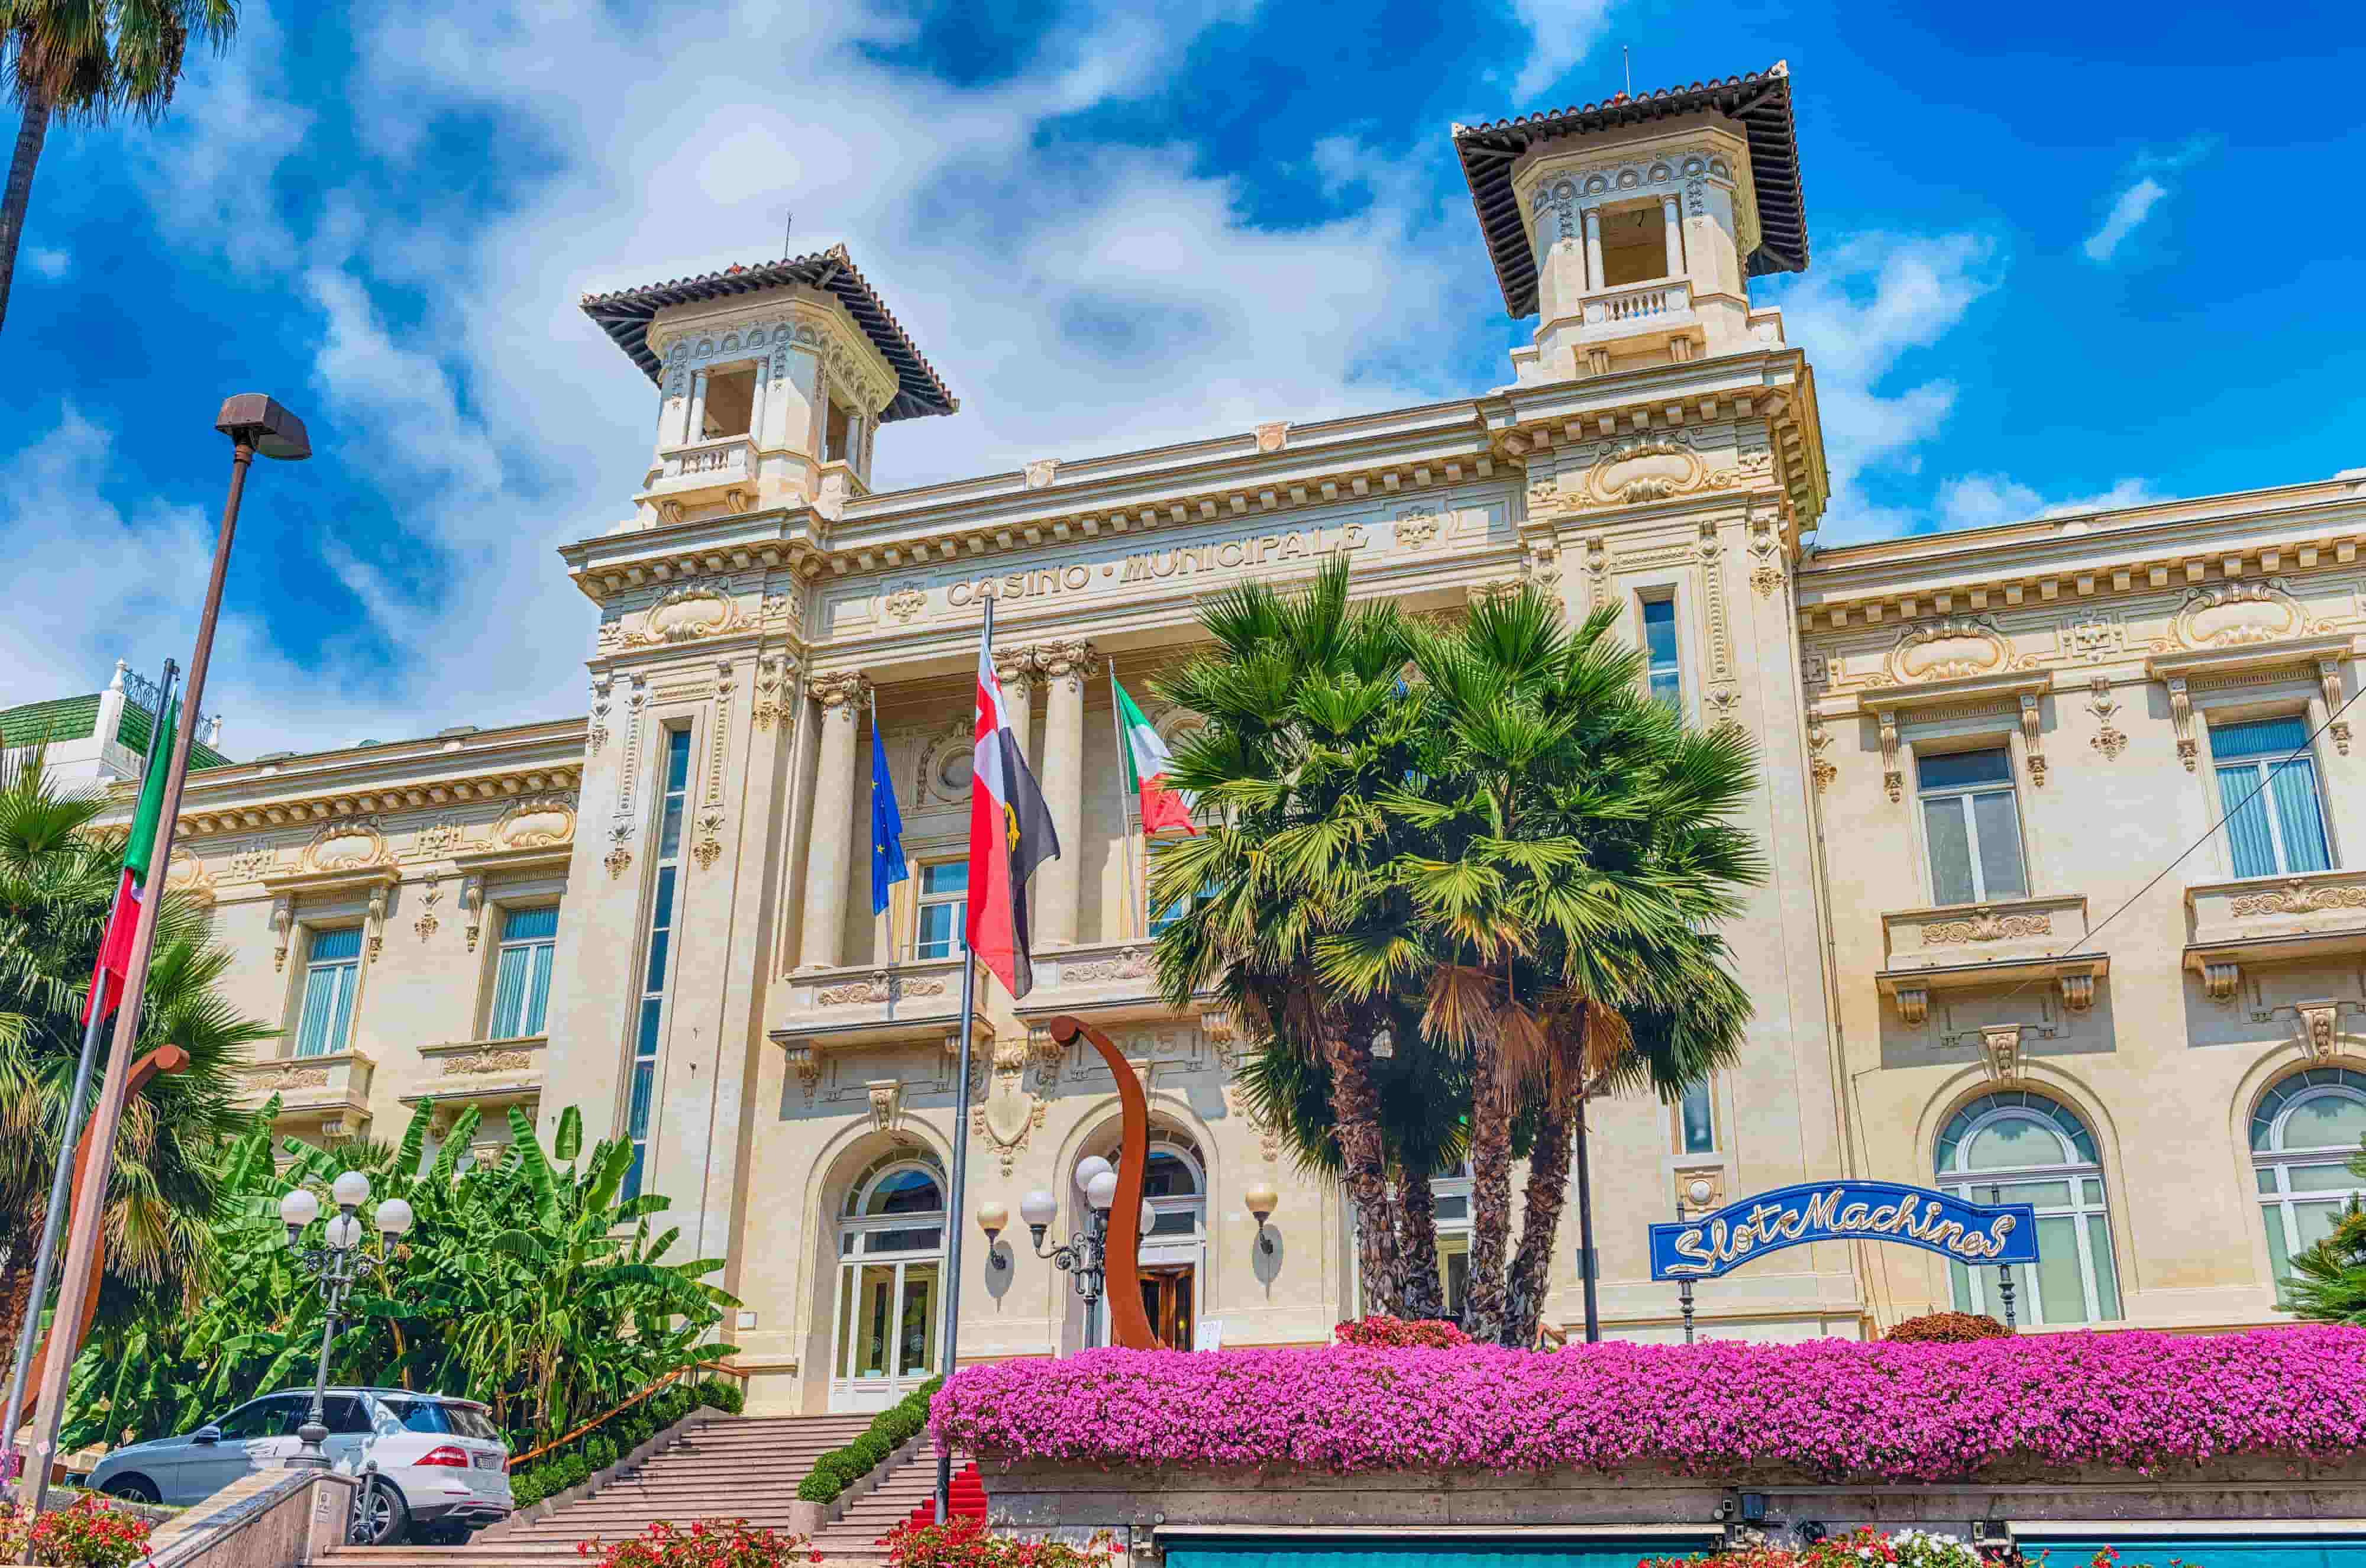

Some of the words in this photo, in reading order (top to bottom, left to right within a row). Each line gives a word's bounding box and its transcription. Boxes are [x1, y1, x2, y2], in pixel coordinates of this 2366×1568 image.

[947, 566, 1091, 606] CASINO
[1120, 522, 1370, 583] MUNICIPALE
[1665, 1204, 1782, 1273] Slot
